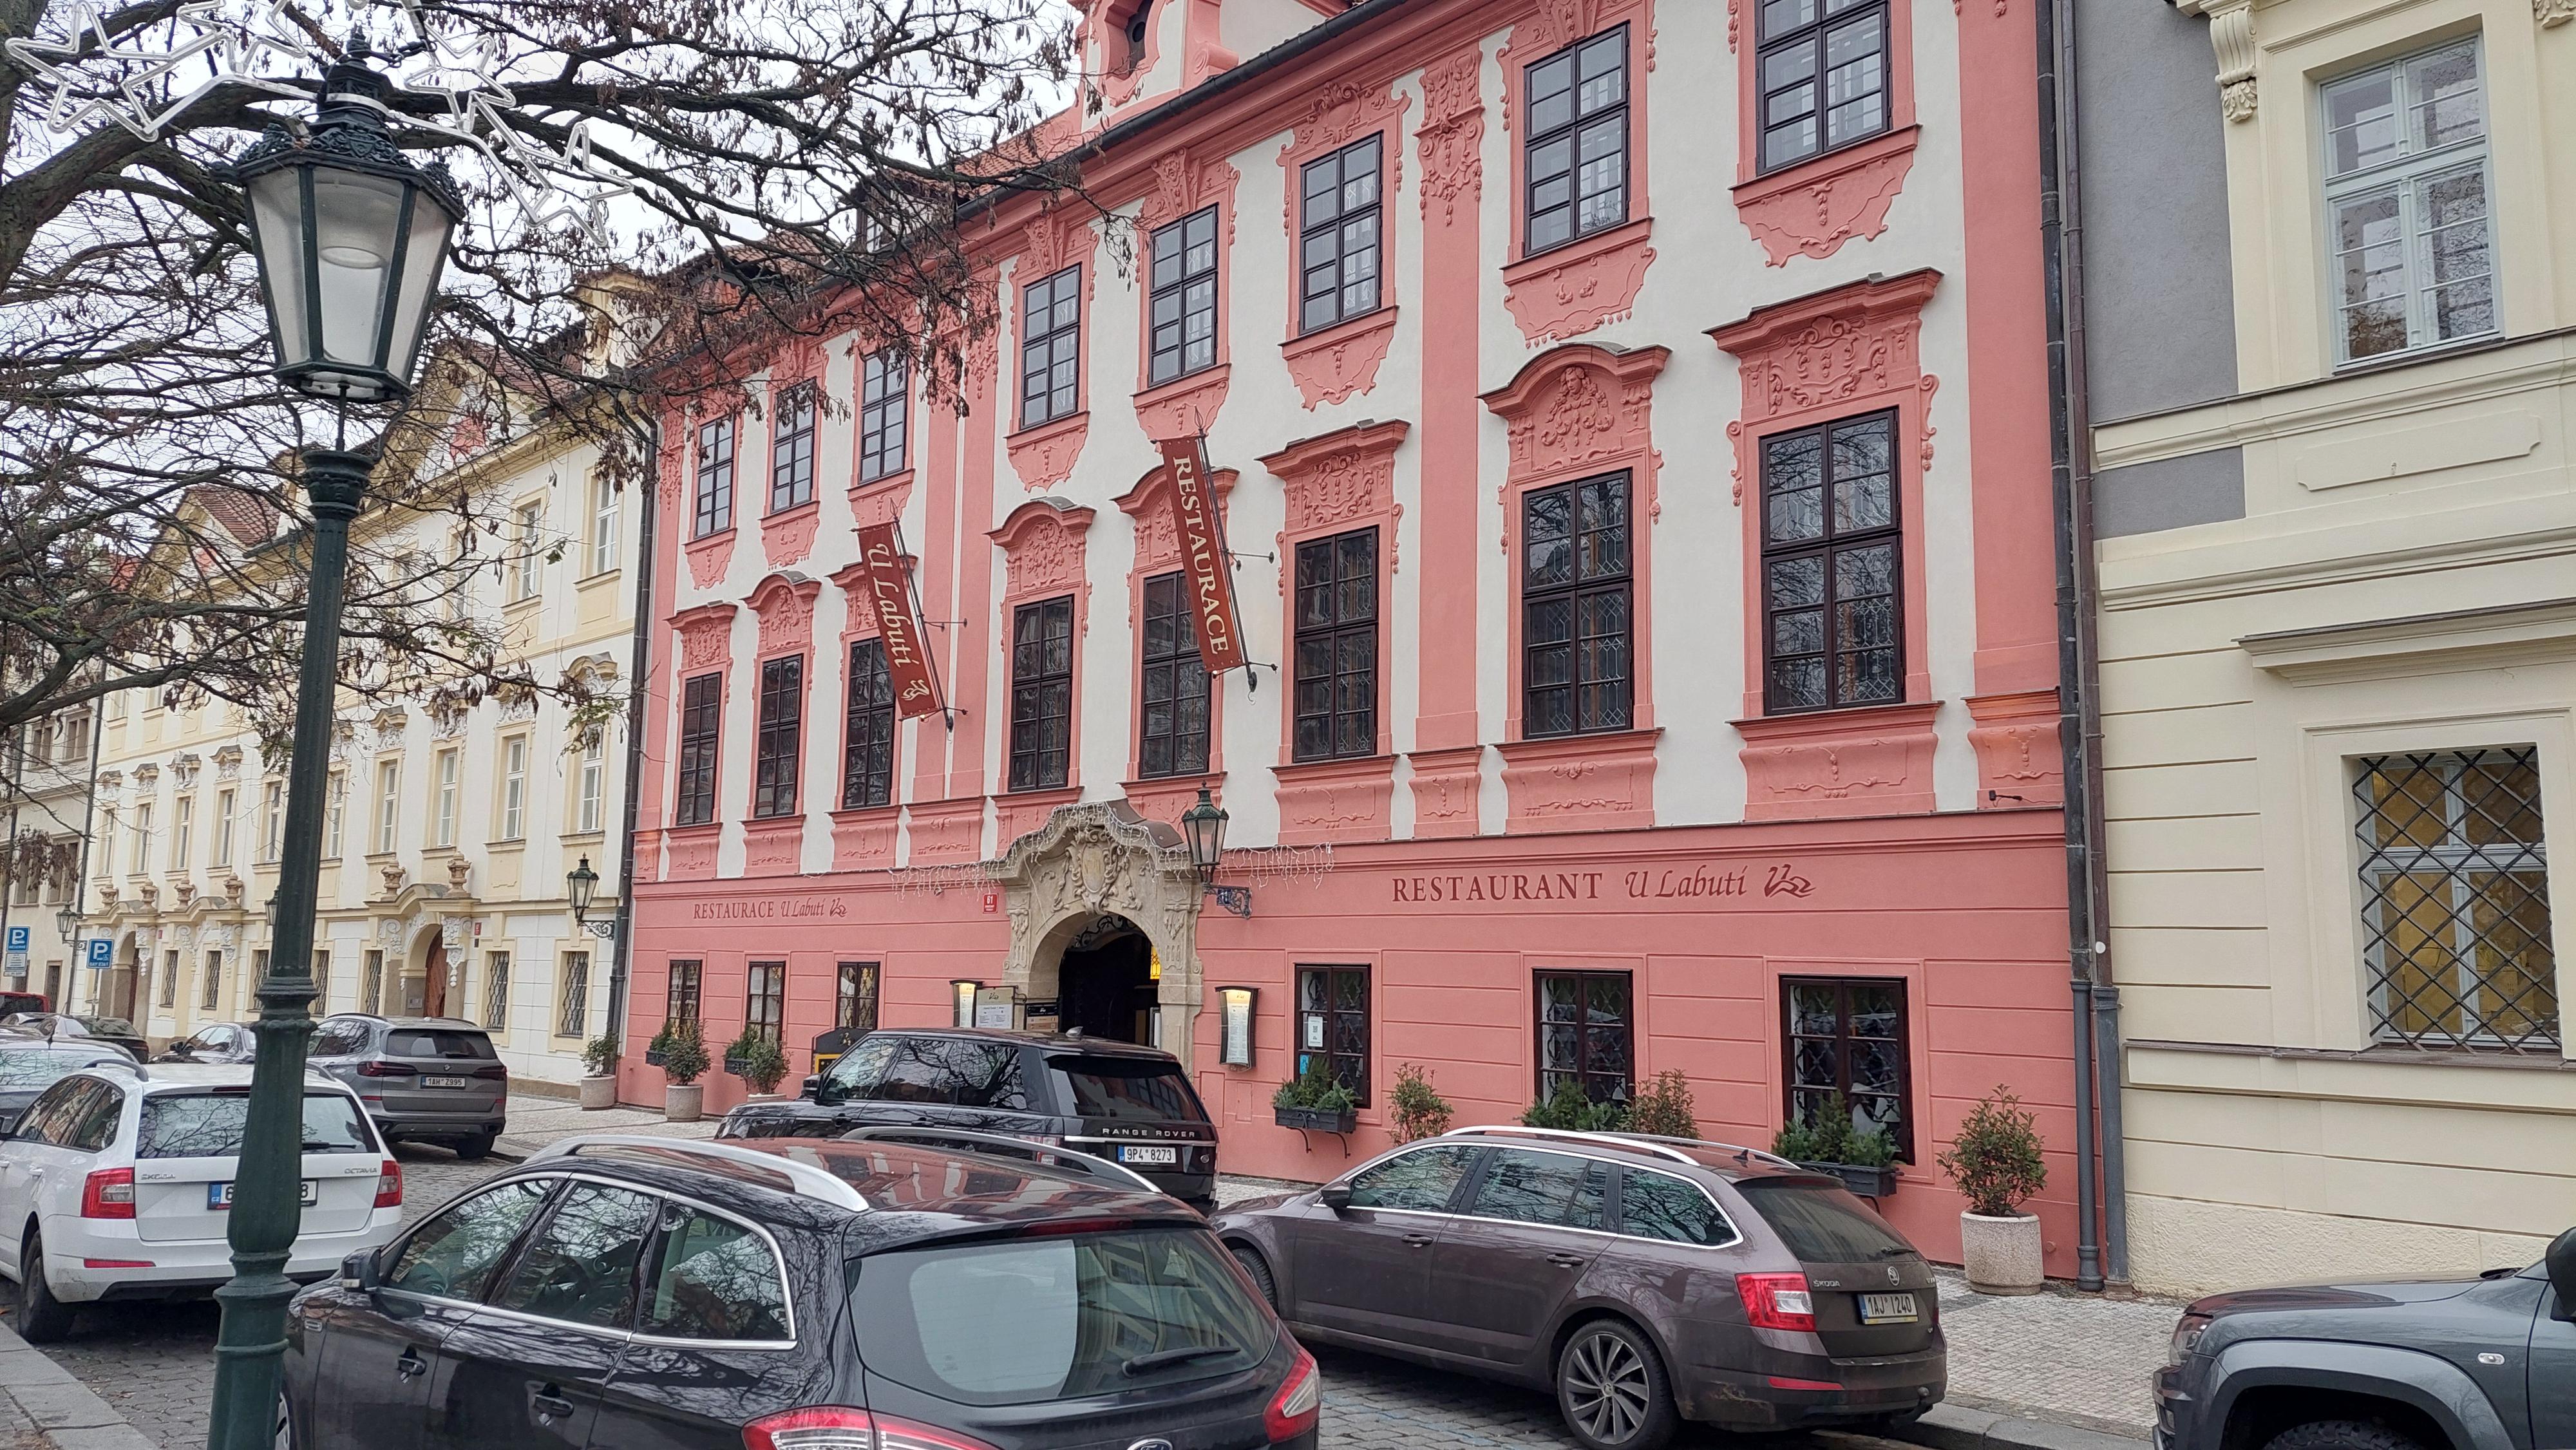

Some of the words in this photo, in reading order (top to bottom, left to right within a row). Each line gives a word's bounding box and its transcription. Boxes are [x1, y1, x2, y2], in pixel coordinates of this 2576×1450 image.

[867, 543, 894, 571] U
[1173, 455, 1229, 655] RESTAURACE
[873, 576, 920, 668] Labutí
[1392, 872, 1603, 902] RESTAURANT
[1624, 871, 1650, 898] U
[1654, 864, 1748, 898] Labutí
[693, 901, 774, 919] RESTAURACE
[781, 901, 791, 918] U
[791, 897, 826, 918] Labutí
[987, 896, 994, 905] 61
[93, 943, 108, 960] P
[1127, 1148, 1143, 1161] 9P4
[1150, 1149, 1172, 1161] 8273
[1868, 1296, 1885, 1315] 1AJ
[1891, 1295, 1912, 1313] 1240
